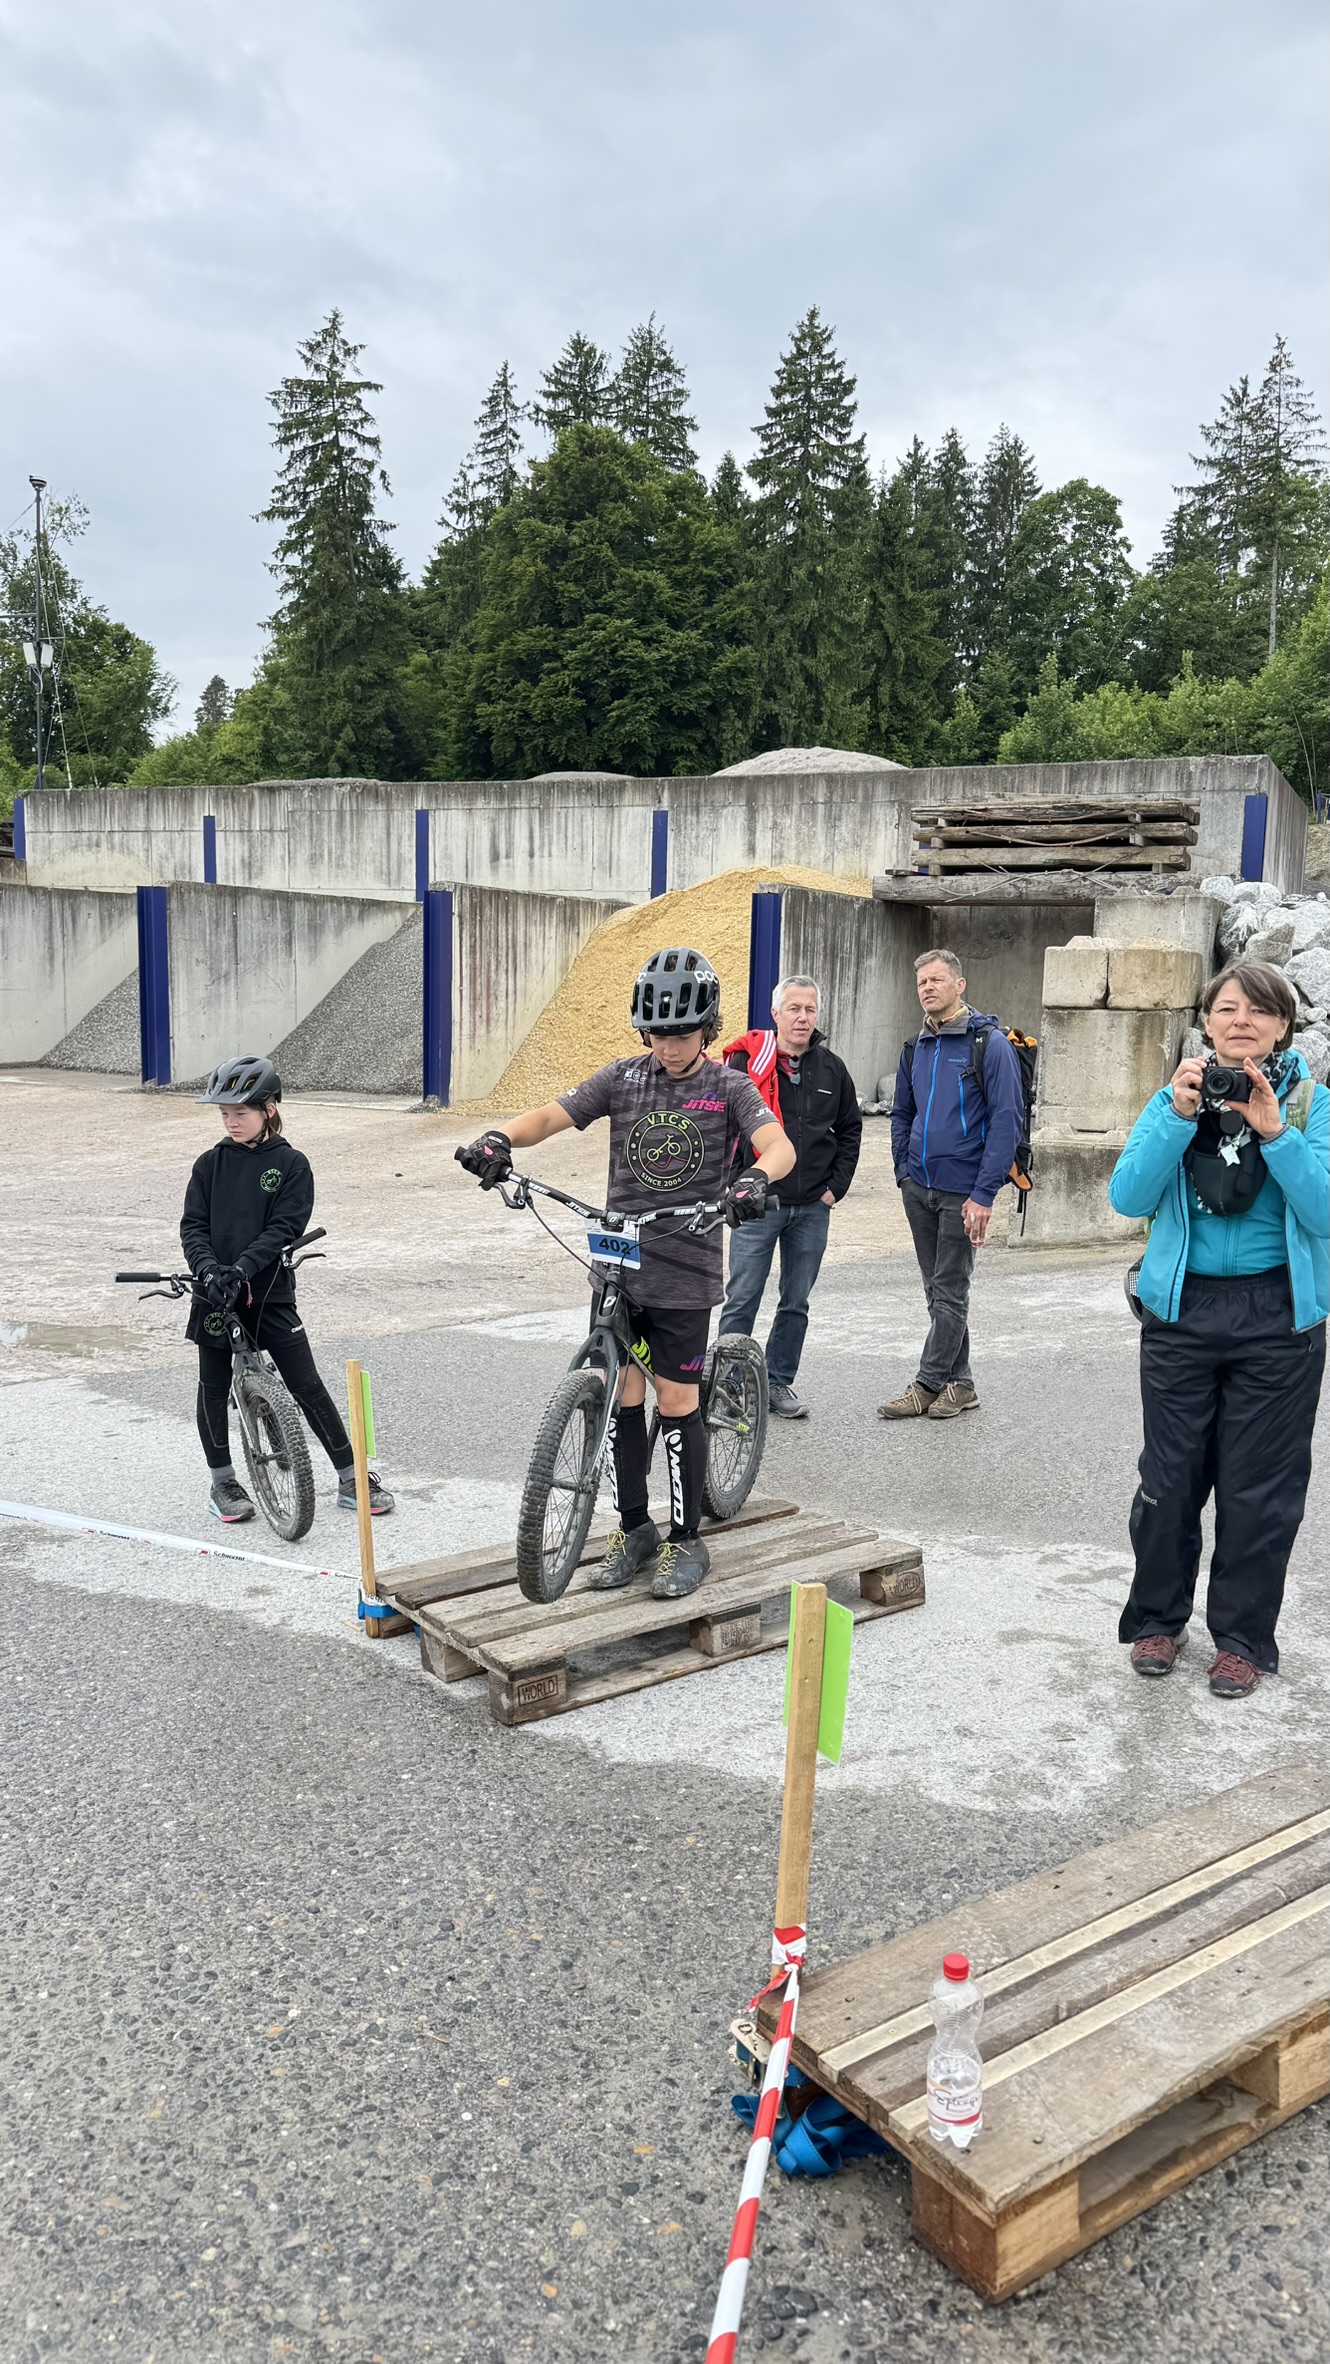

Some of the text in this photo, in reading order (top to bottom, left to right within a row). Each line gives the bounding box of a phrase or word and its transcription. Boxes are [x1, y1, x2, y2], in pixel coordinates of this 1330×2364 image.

[647, 1113, 691, 1130] VTCS
[640, 1172, 682, 1187] SINCE 2004
[598, 1237, 631, 1255] 402
[521, 1679, 556, 1702] WORLD
